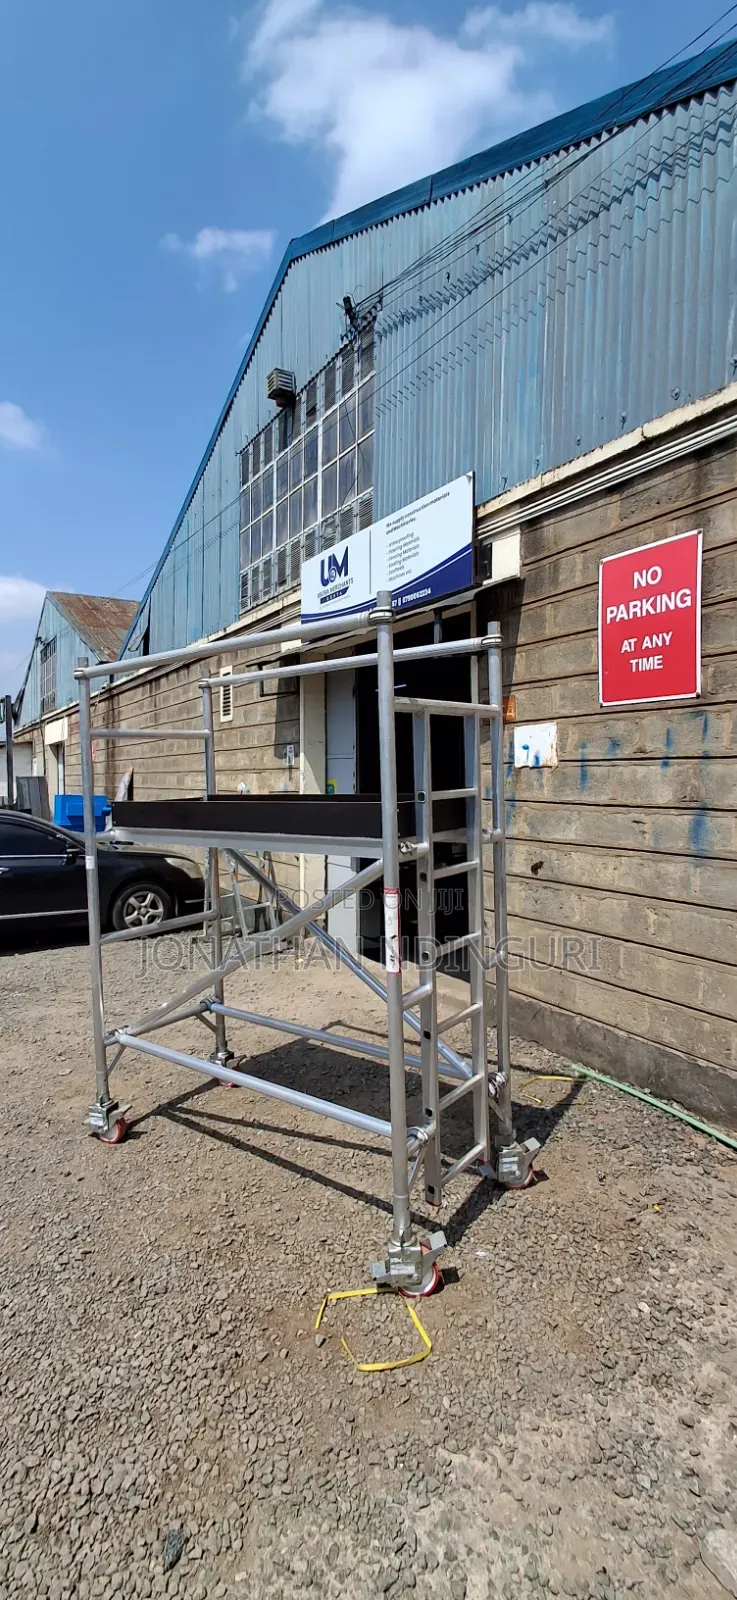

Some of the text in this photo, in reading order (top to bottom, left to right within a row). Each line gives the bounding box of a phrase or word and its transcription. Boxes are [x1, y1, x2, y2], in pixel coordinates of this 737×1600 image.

[330, 577, 354, 592] MERCHANTS
[633, 566, 662, 590] NO
[606, 588, 692, 624] PARKING
[620, 632, 673, 654] AT ANY
[630, 655, 664, 672] TIME
